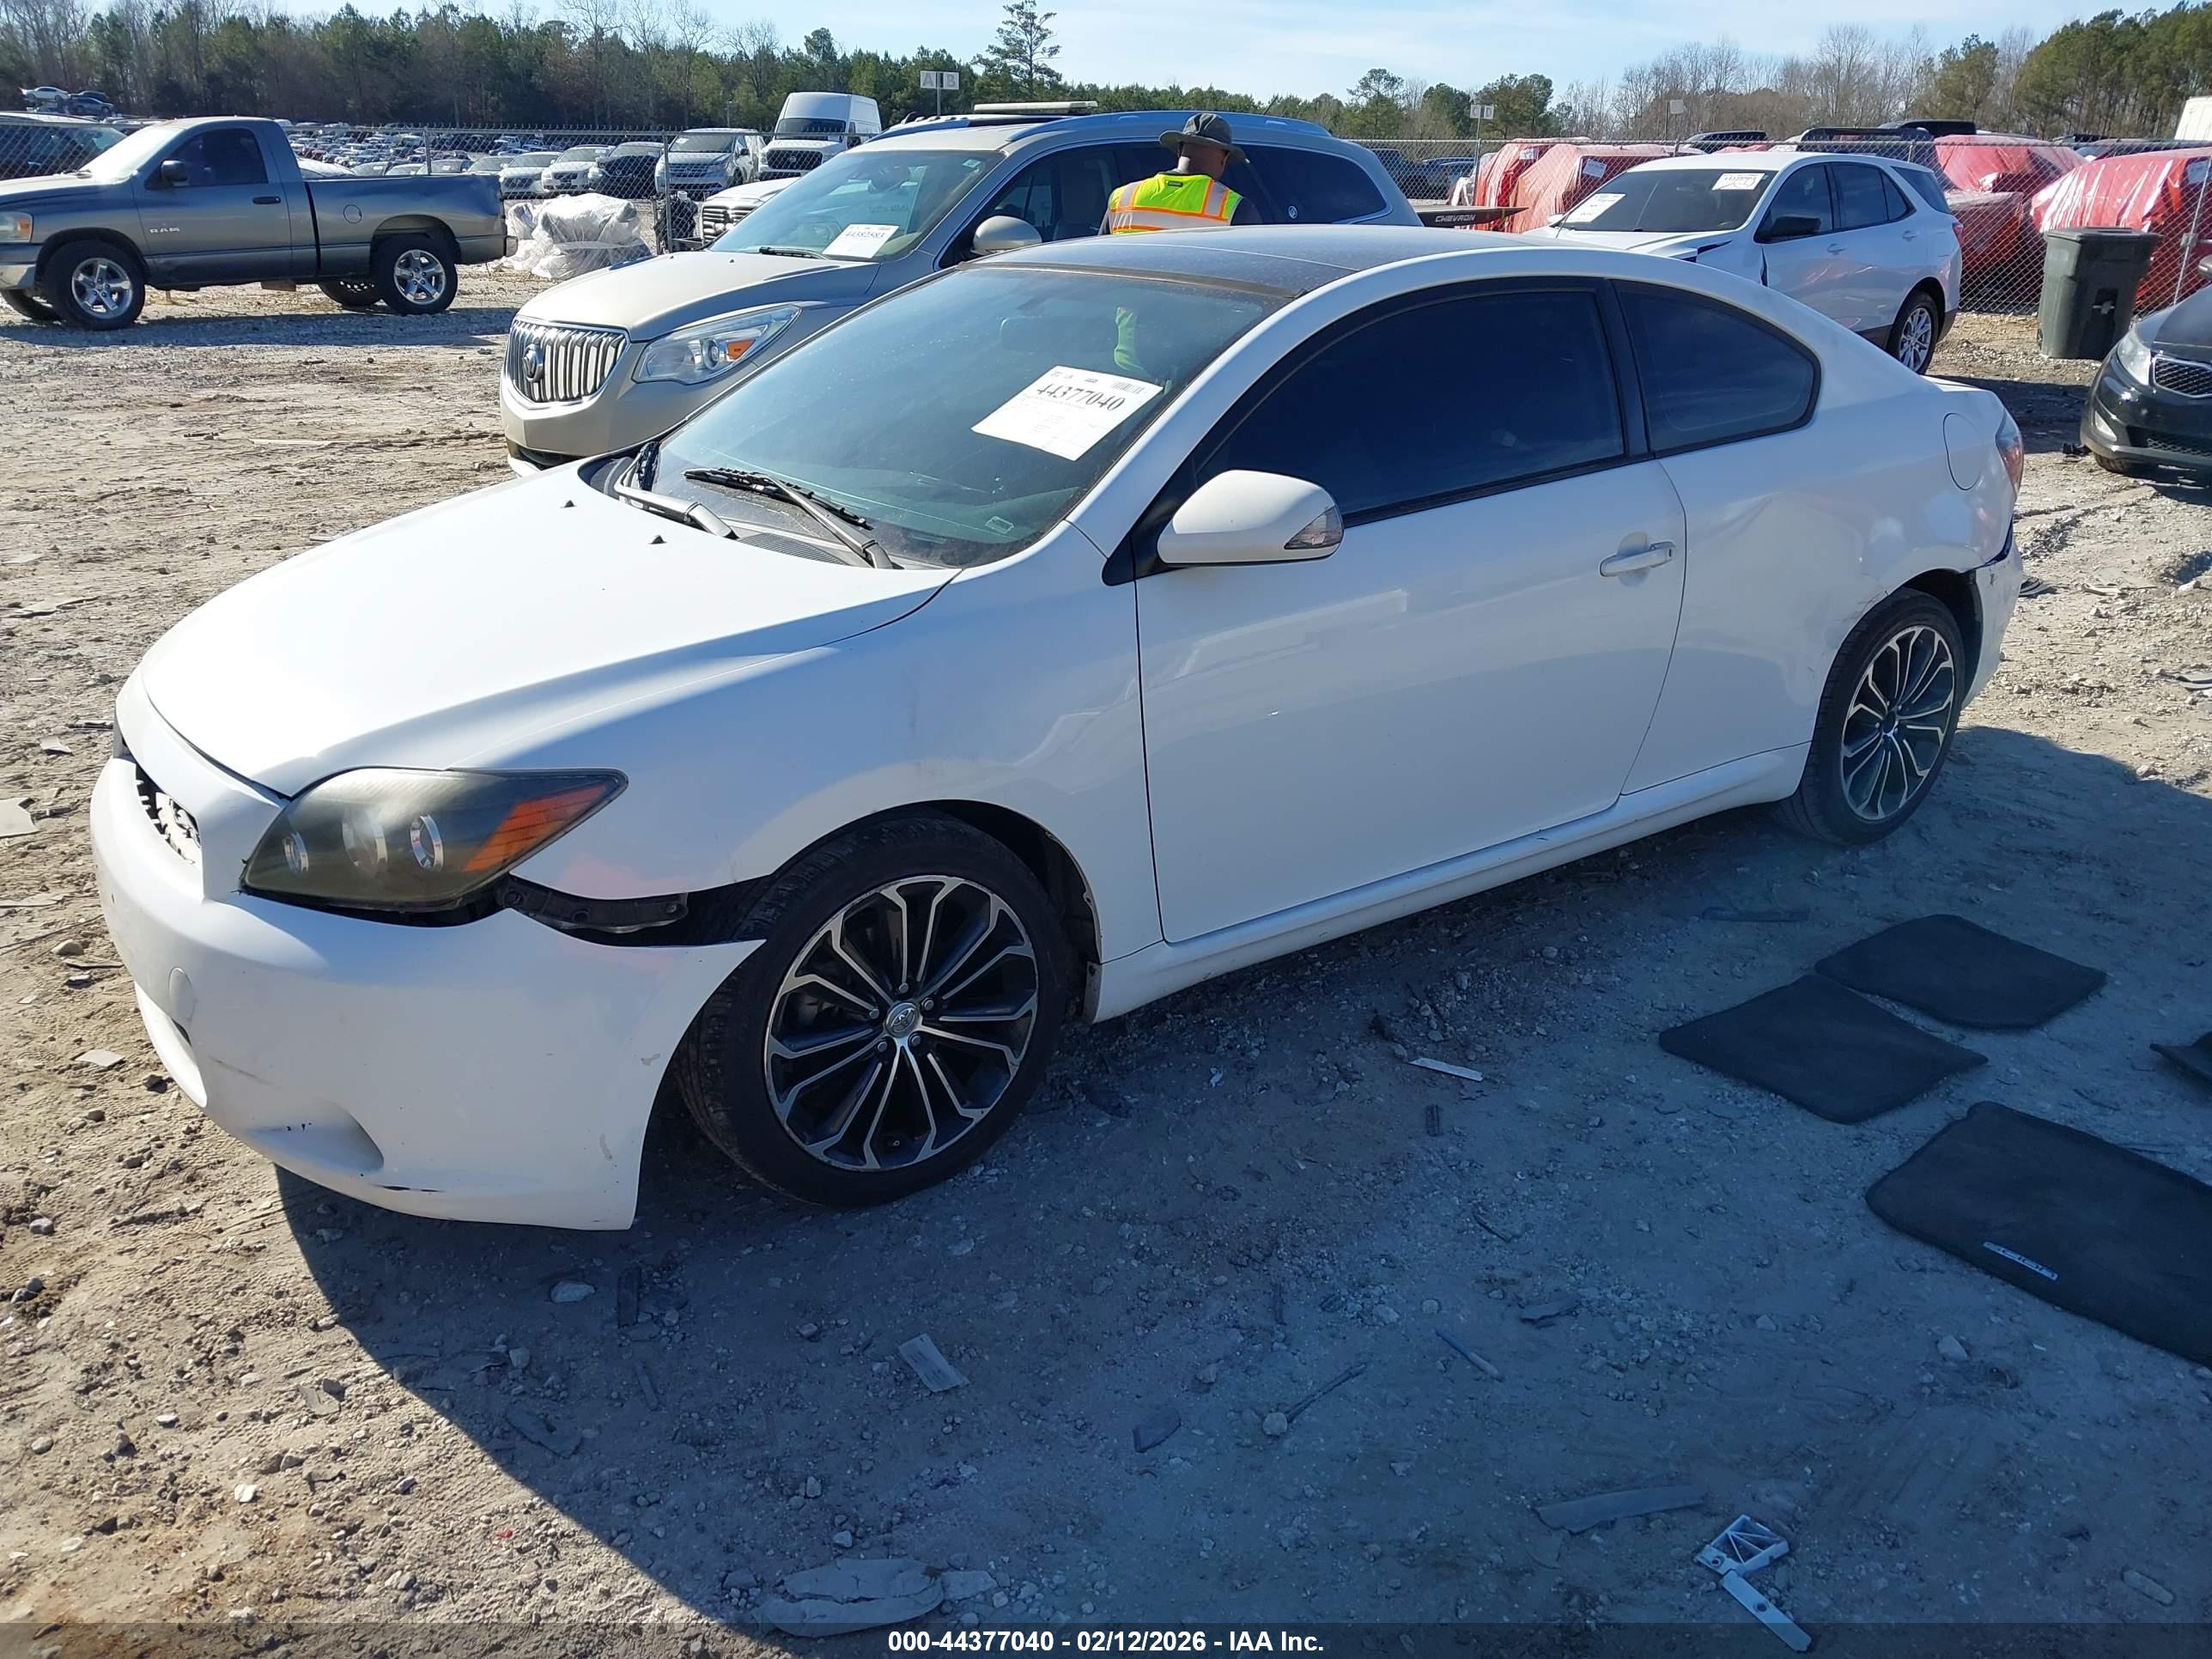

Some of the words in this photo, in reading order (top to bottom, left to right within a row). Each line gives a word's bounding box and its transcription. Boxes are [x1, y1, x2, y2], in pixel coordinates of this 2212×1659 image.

[922, 73, 934, 87] A
[946, 74, 956, 88] B
[1435, 214, 1476, 222] CHEVRON
[1036, 383, 1126, 411] 44377040
